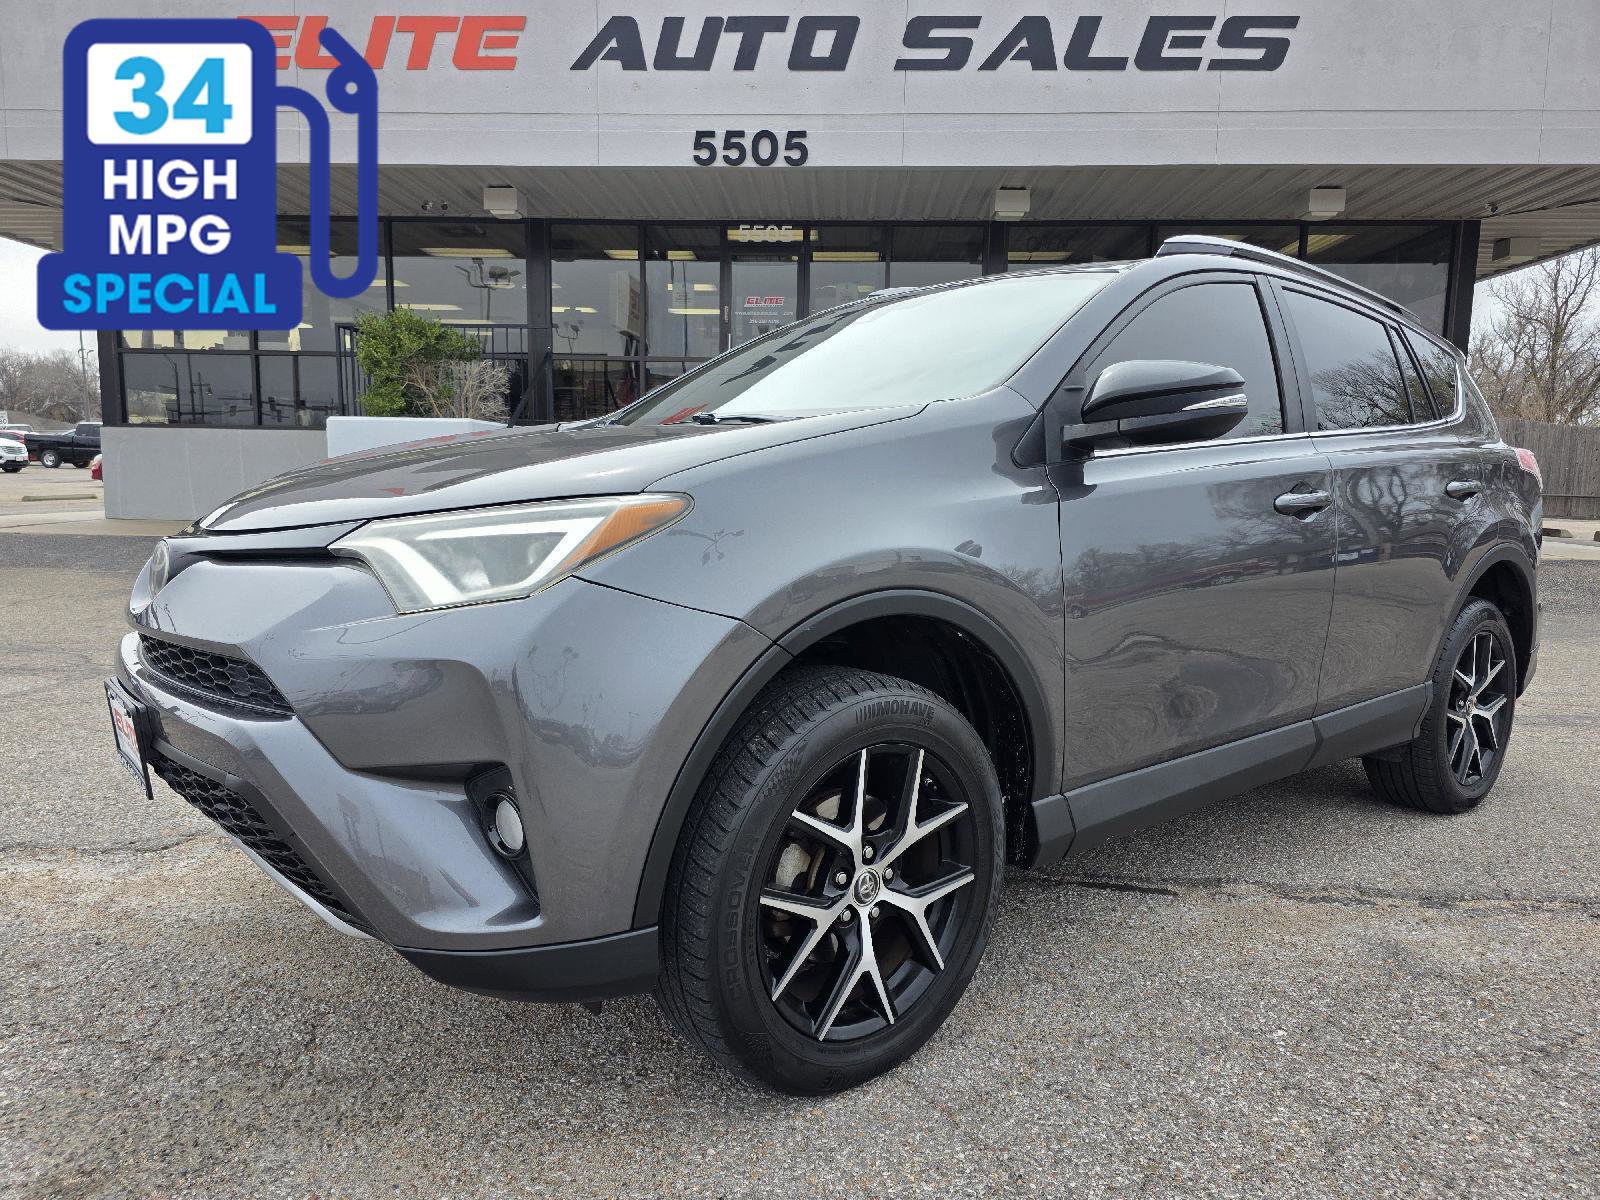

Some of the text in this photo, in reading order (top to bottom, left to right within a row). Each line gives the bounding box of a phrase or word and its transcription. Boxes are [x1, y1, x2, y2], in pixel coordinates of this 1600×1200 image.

[569, 15, 860, 71] AUTO
[893, 15, 1300, 71] SALES
[693, 129, 809, 167] 5505
[739, 224, 793, 242] 5505
[745, 296, 785, 306] ELITE
[875, 699, 935, 721] MOHAVE
